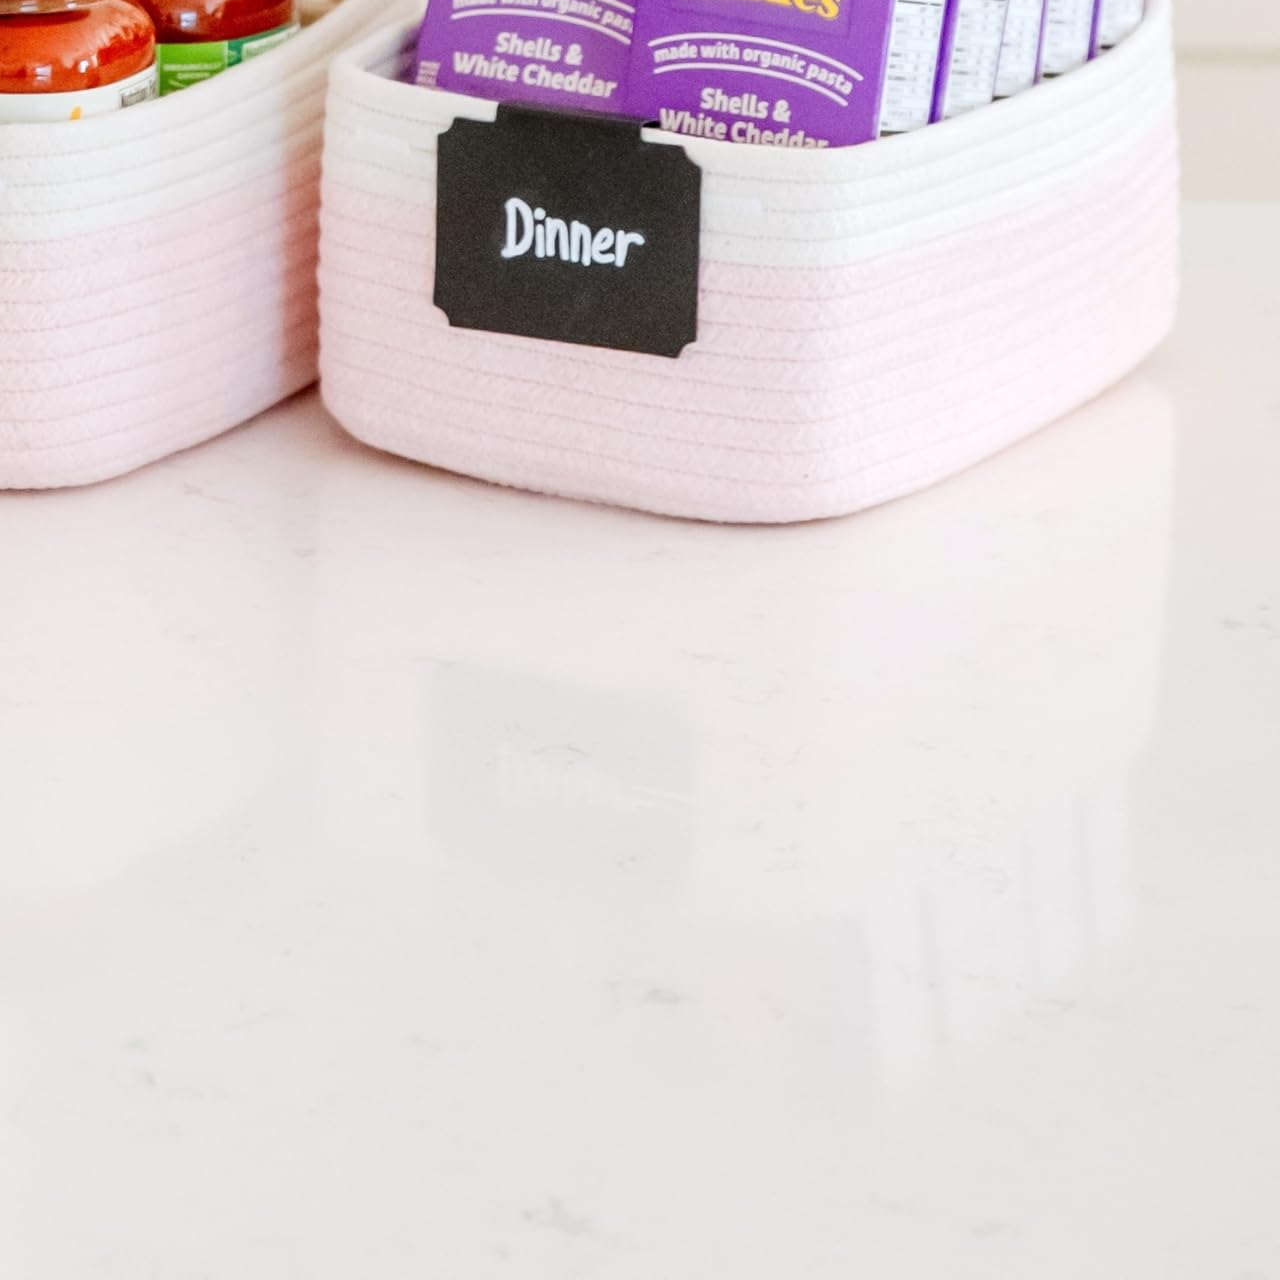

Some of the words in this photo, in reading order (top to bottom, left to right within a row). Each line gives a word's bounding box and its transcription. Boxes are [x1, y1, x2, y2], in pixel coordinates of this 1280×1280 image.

[600, 9, 634, 34] pas
[495, 32, 562, 62] Shells
[564, 43, 584, 66] &
[453, 51, 520, 82] White
[522, 63, 619, 98] Cheddar
[654, 42, 698, 63] made
[700, 41, 740, 60] with
[742, 48, 806, 73] organic
[805, 63, 854, 95] pasta
[700, 87, 769, 119] Shells
[772, 99, 792, 123] &
[659, 108, 728, 140] White
[500, 197, 646, 268] Dinner
